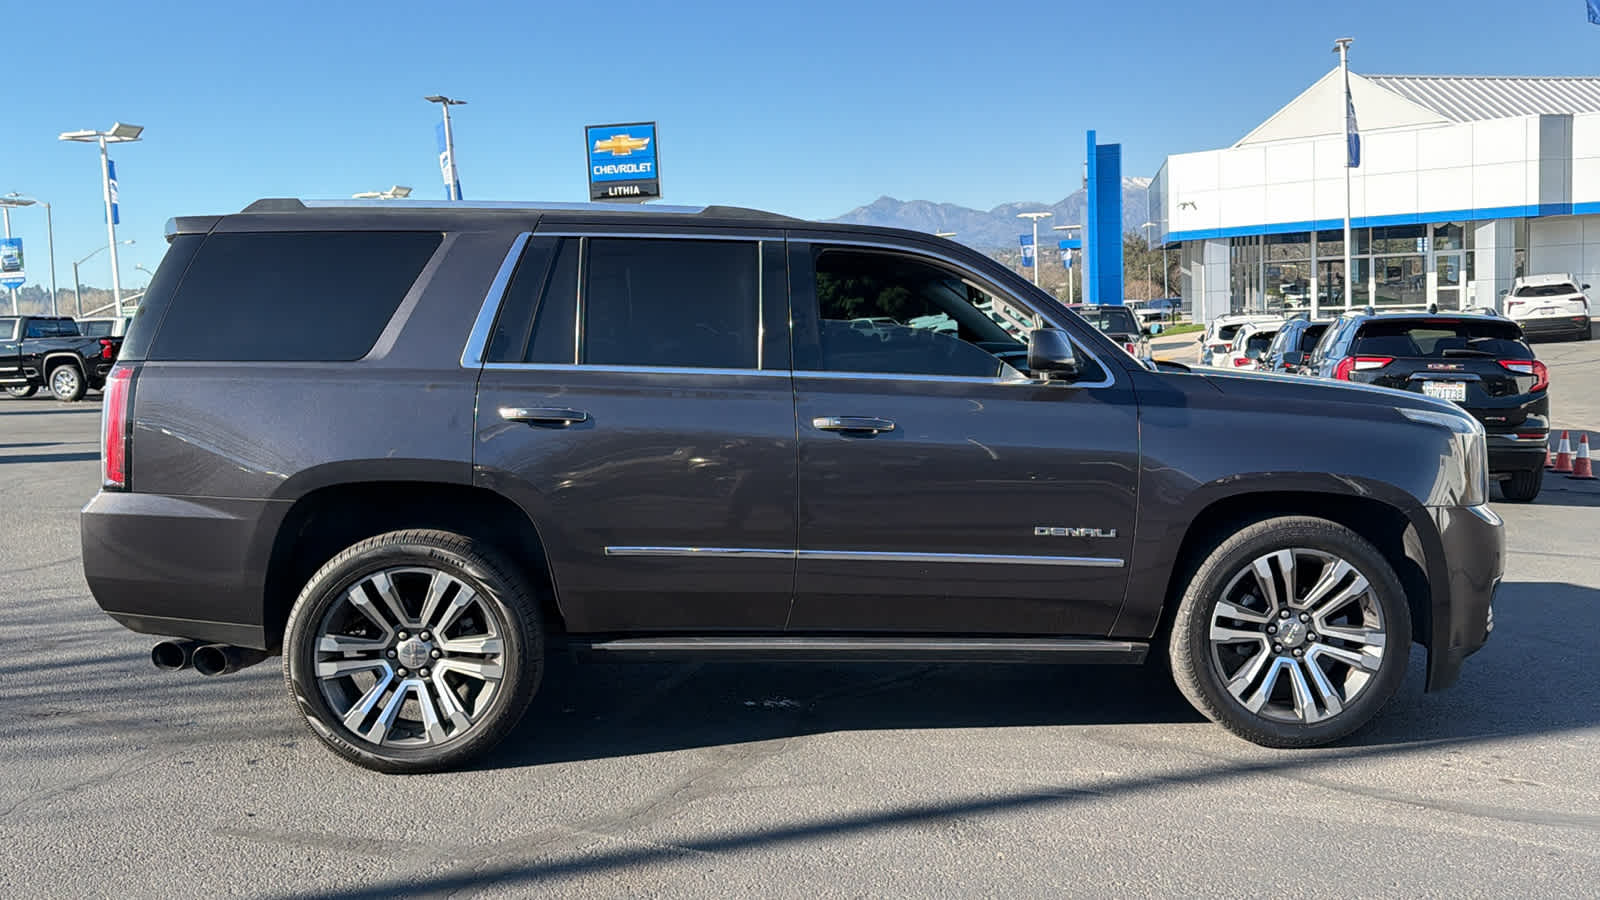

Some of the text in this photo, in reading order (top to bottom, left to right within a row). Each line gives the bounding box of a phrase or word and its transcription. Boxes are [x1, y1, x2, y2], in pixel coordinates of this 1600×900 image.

[593, 162, 652, 175] CHEVROLET
[608, 185, 640, 197] LITHIA
[1034, 526, 1117, 538] DENALI
